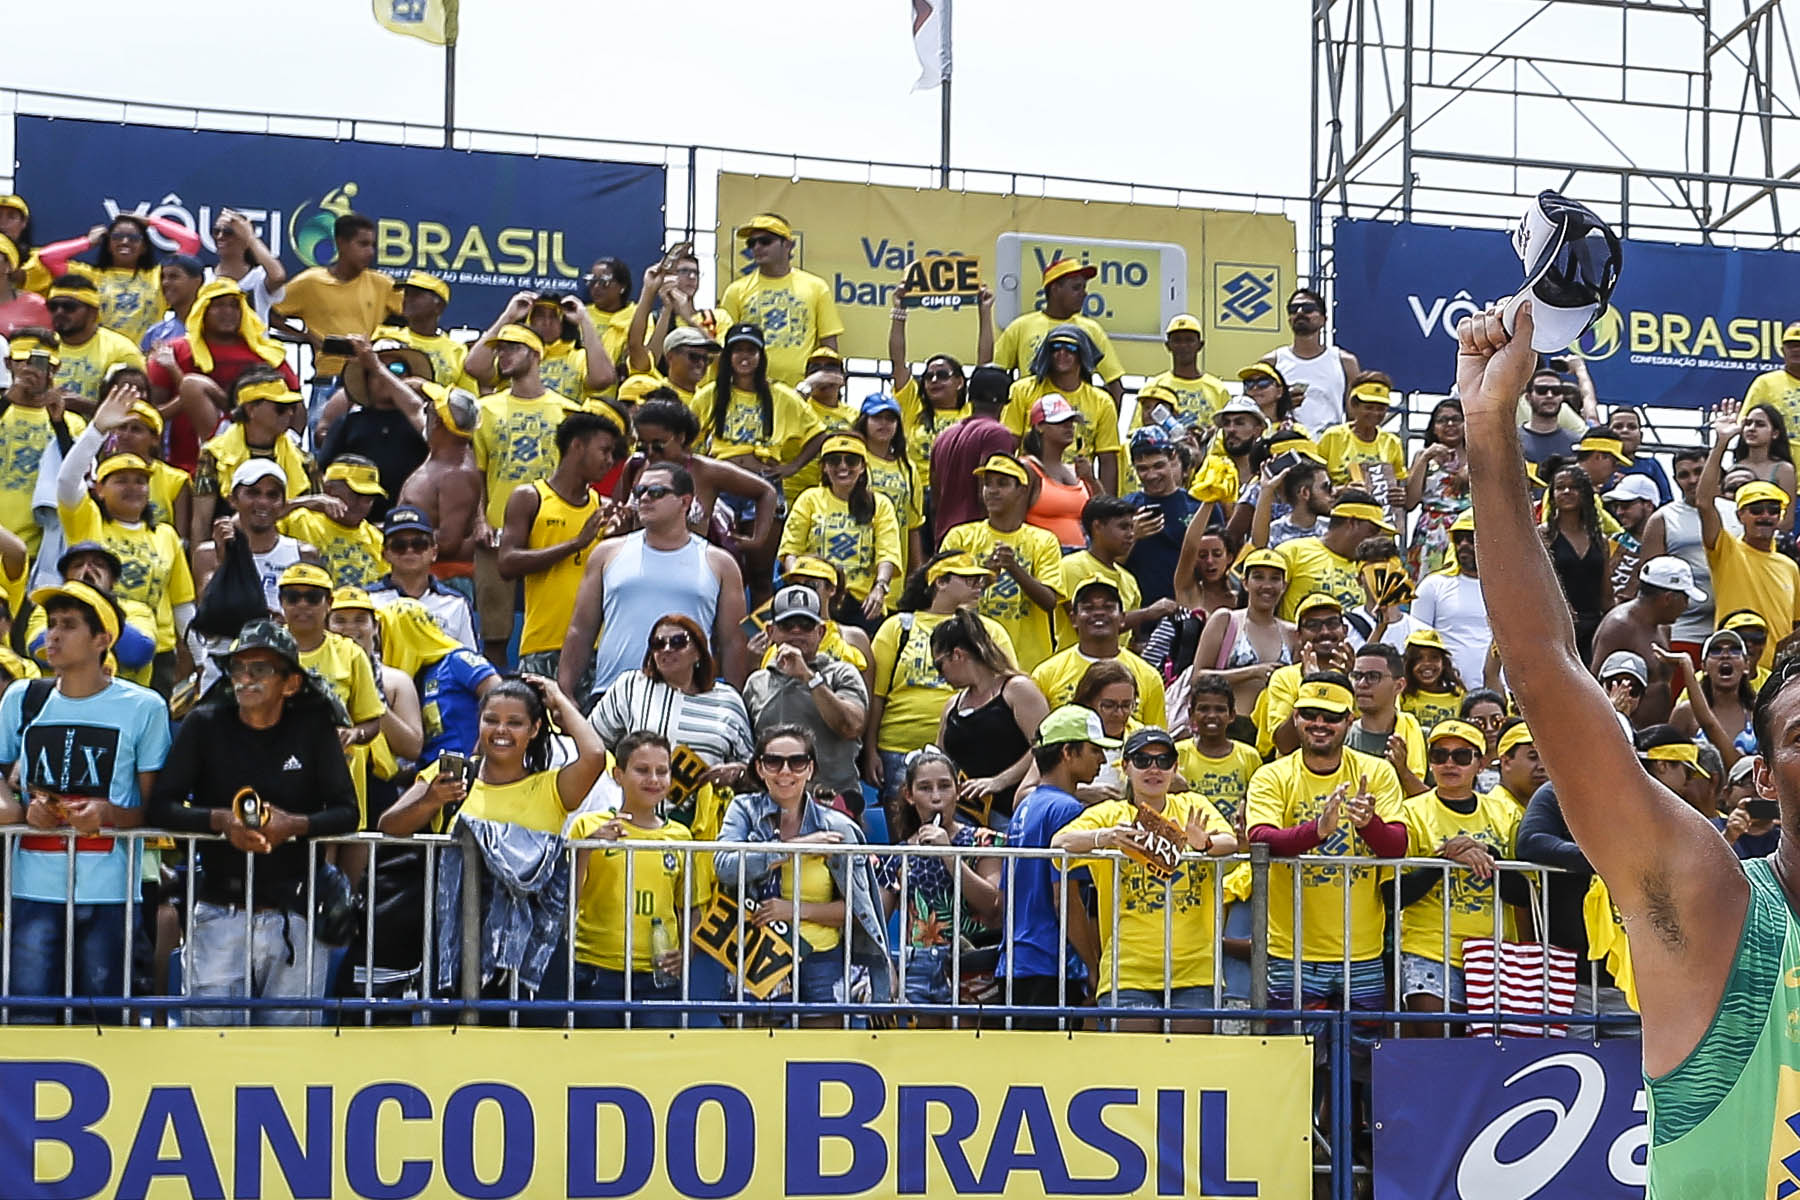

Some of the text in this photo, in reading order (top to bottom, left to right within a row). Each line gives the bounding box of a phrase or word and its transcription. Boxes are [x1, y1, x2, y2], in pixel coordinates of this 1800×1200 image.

[377, 218, 580, 277] BRASIL
[903, 258, 980, 293] ACE
[1100, 261, 1149, 287] no
[921, 294, 961, 307] CIMED
[634, 889, 654, 916] 10
[696, 900, 790, 986] ACE
[566, 1083, 756, 1200] DO
[785, 1060, 1259, 1198] BRASIL
